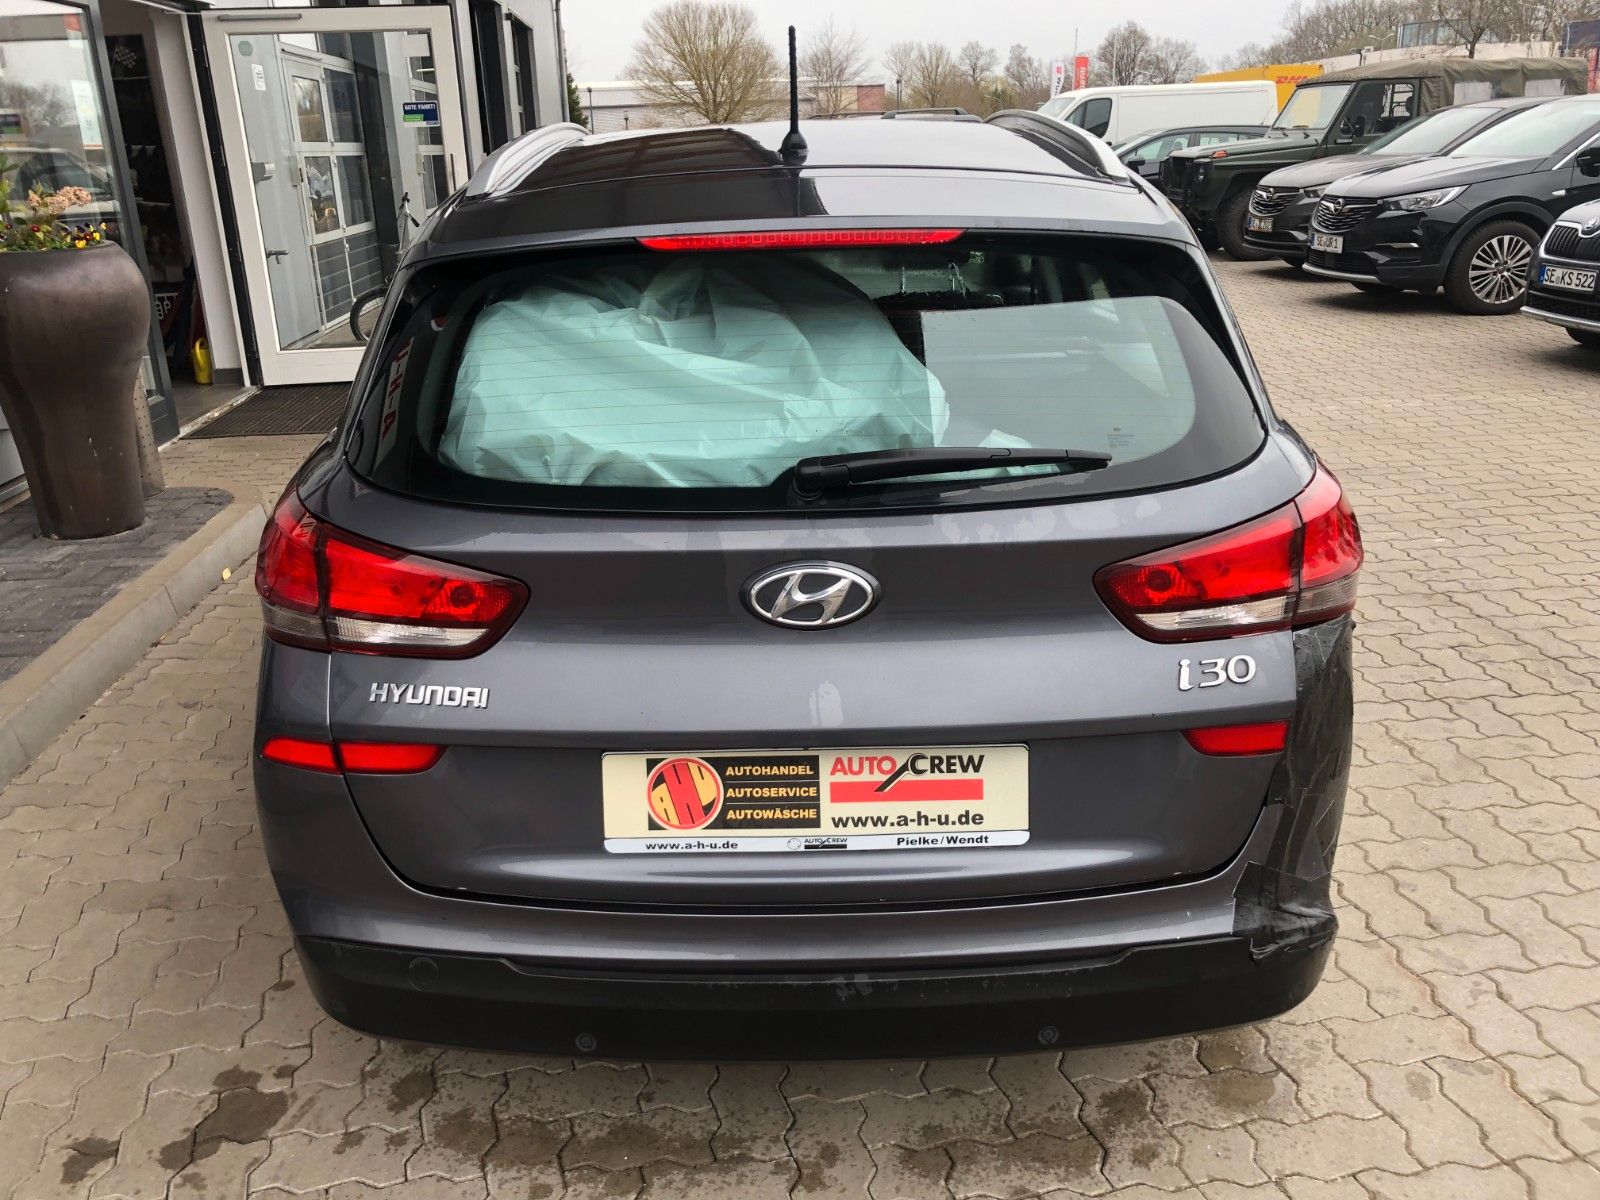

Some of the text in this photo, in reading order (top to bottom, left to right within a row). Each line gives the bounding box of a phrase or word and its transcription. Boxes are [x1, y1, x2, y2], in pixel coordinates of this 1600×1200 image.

[1544, 268, 1595, 289] SE KS 522
[369, 682, 489, 708] HYUNDAI
[726, 765, 814, 776] AUTOHANDEL
[830, 753, 985, 776] AUTO CREW
[726, 787, 818, 797] AUTOSERVICE
[727, 807, 817, 819] AUTOWÄSCHE
[831, 810, 984, 828] www.a-h-u.de
[645, 841, 738, 850] www.a-h-u.de
